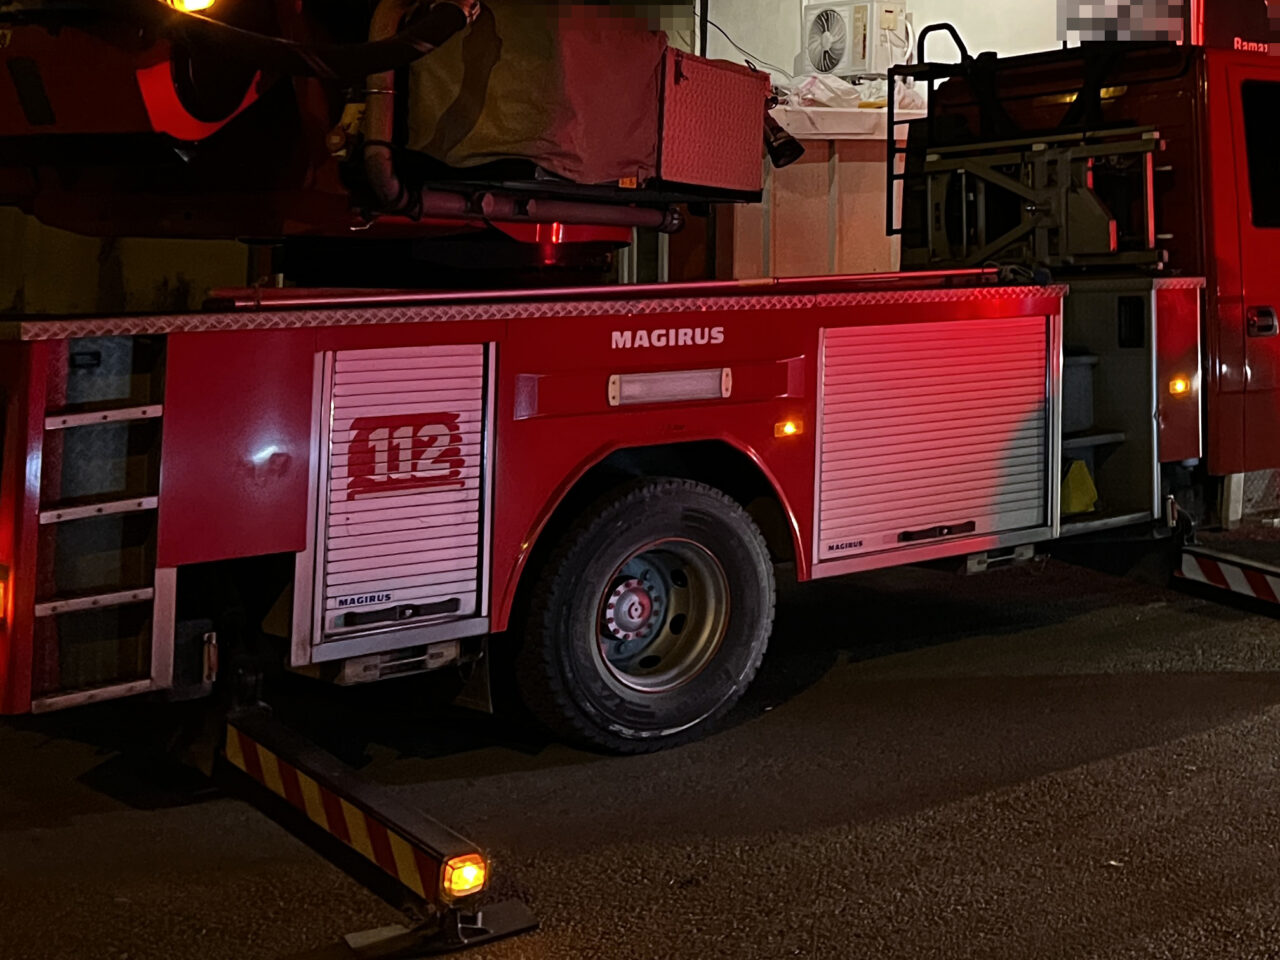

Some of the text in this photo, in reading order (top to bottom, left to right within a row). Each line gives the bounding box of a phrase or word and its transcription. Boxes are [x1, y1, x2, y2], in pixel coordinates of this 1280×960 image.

[611, 326, 725, 349] MAGIRUS
[367, 423, 452, 483] 112
[828, 540, 864, 551] MAGIRUS
[338, 593, 392, 607] MAGIRUS
